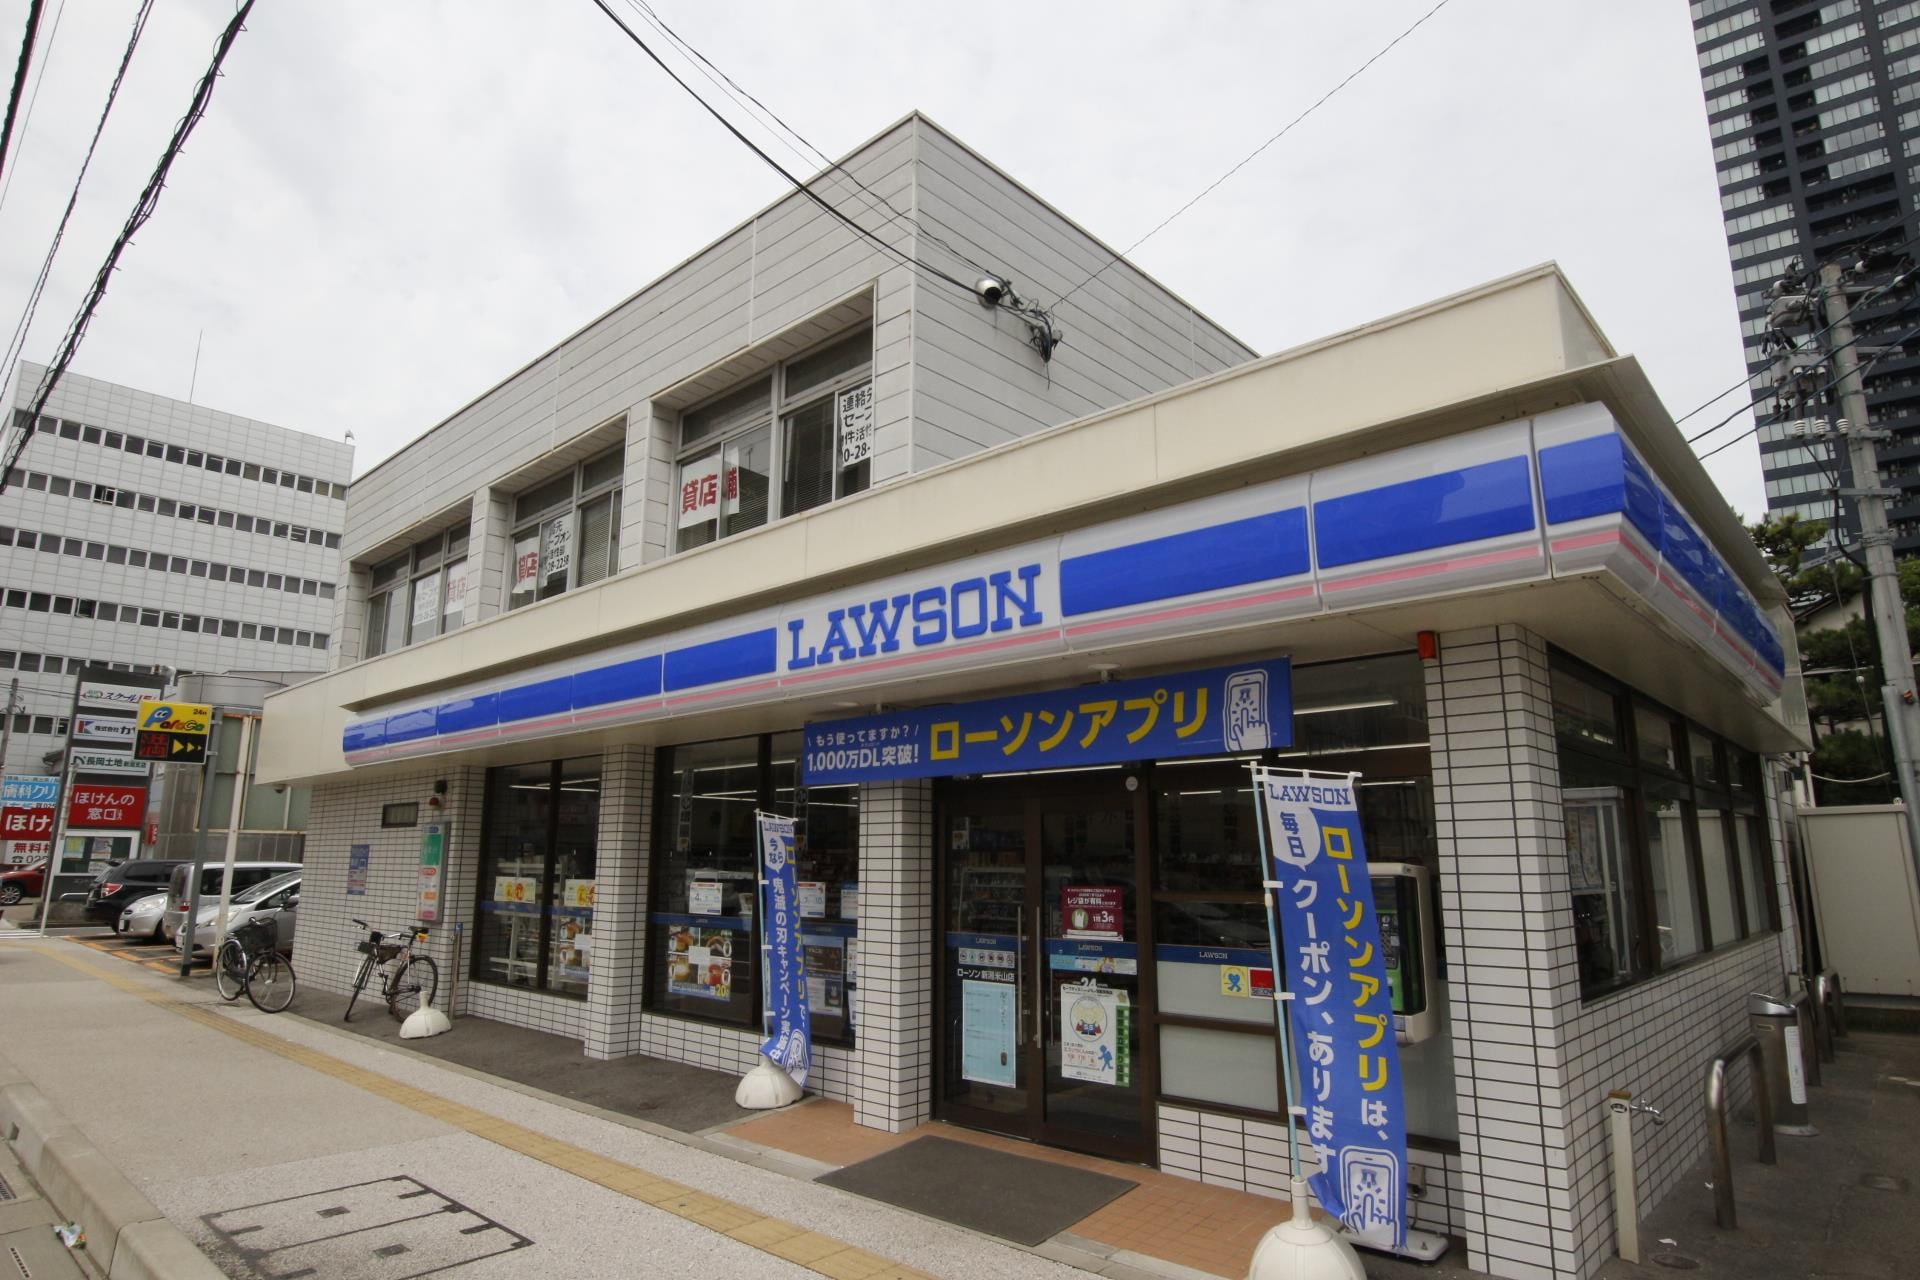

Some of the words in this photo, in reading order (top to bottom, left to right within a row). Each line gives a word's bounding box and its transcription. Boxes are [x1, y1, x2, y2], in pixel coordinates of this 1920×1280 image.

[787, 563, 1042, 670] LAWSON
[929, 687, 1208, 762] ローソンアプリ
[807, 743, 919, 772] 1,000万DL突破!
[74, 791, 135, 806] ほけんの
[1268, 783, 1351, 806] LAWSON
[5, 814, 53, 832] ほけ
[1280, 811, 1306, 858] 毎日
[1198, 951, 1229, 960] LAWSON
[1321, 826, 1389, 1142] ローソンアプリは、
